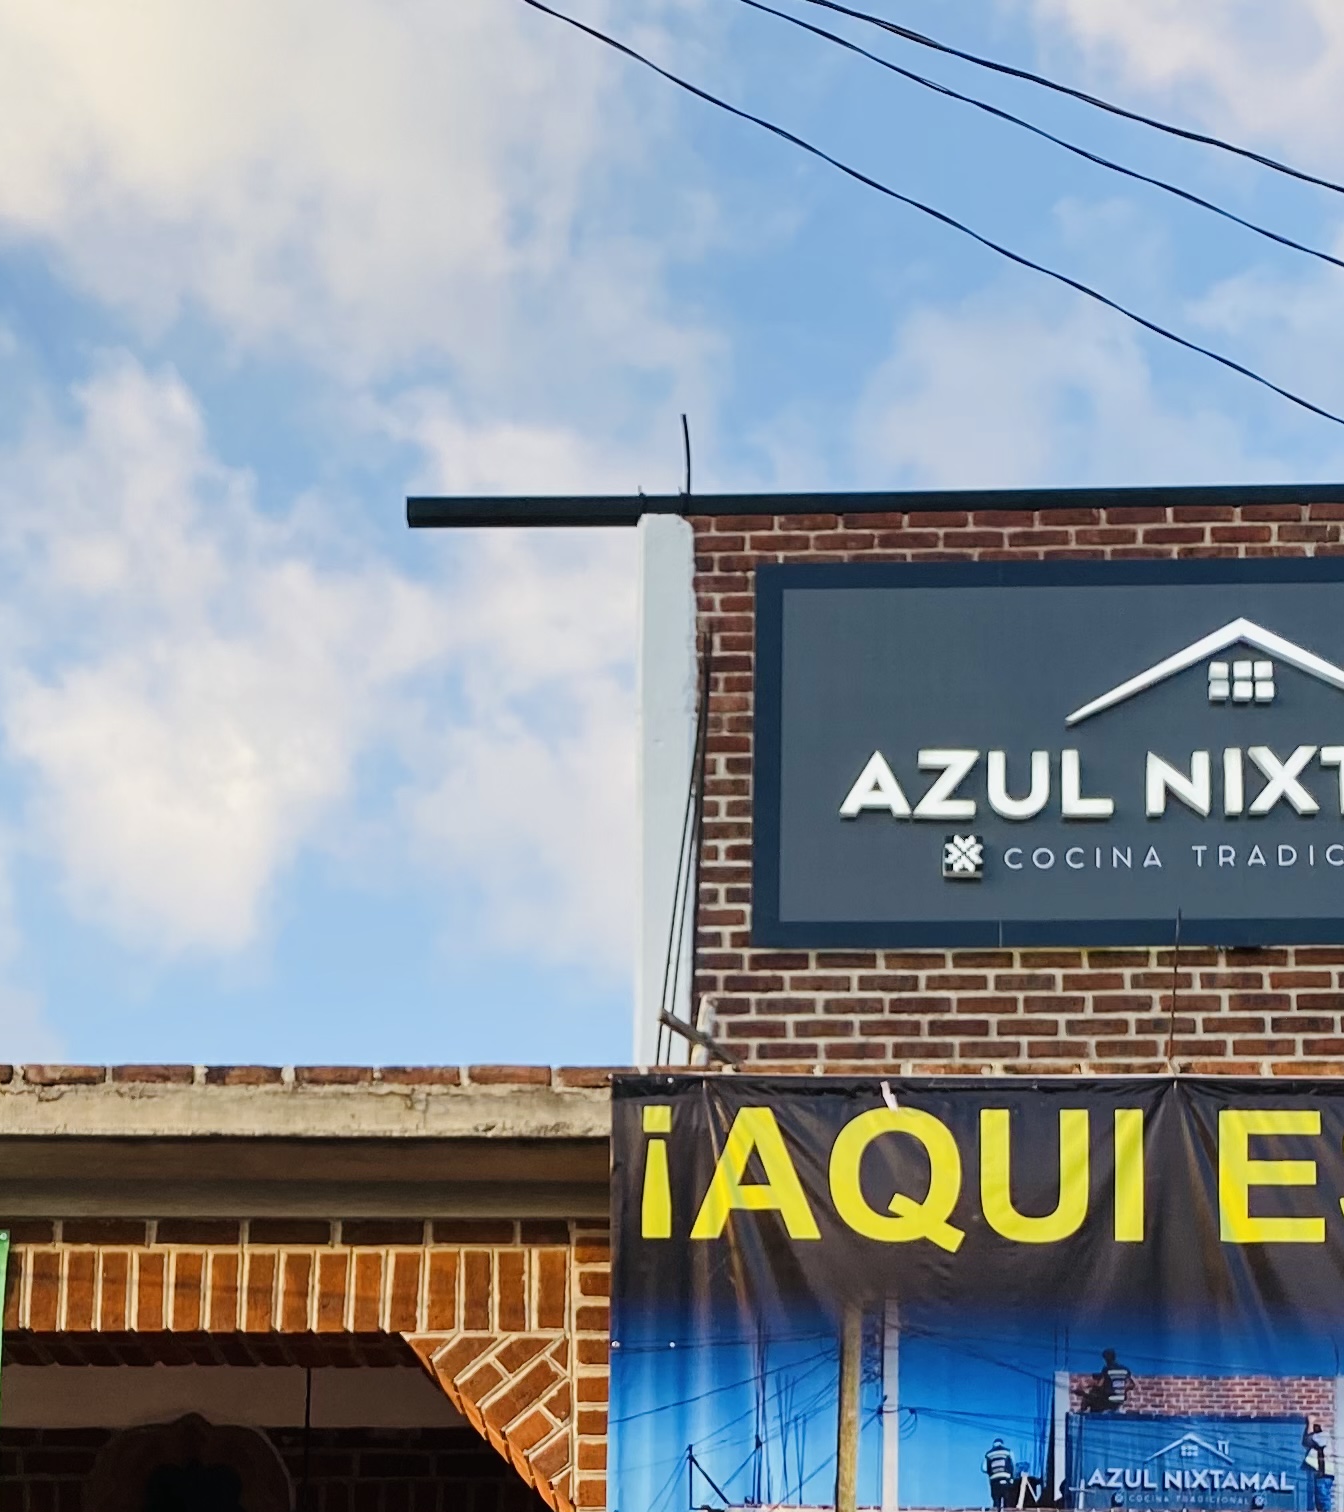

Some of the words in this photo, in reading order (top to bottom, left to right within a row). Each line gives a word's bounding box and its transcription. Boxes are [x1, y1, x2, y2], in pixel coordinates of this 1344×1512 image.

[840, 749, 1114, 819] AZUL
[1004, 846, 1163, 870] COCINA
[642, 1105, 1145, 1253] ¡AQUI
[1087, 1468, 1158, 1489] AZUL
[1164, 1468, 1294, 1491] NIXTAMAL
